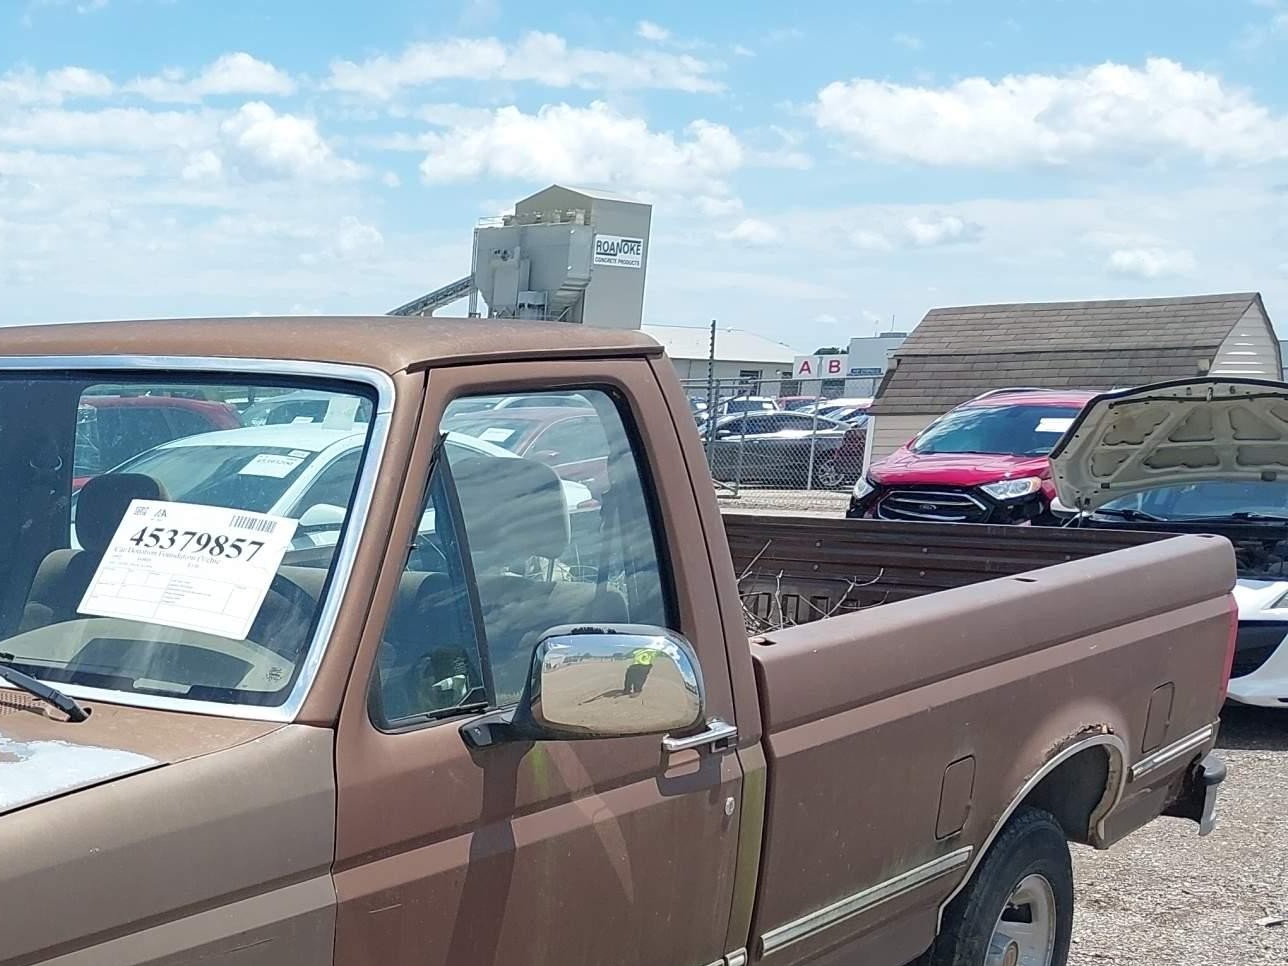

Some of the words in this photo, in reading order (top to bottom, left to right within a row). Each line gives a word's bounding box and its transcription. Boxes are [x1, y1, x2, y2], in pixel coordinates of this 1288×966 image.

[596, 239, 641, 256] ROANOKE
[618, 258, 640, 266] PRODUCTS
[798, 360, 812, 374] A
[828, 359, 841, 374] B
[129, 526, 265, 562] 45379857
